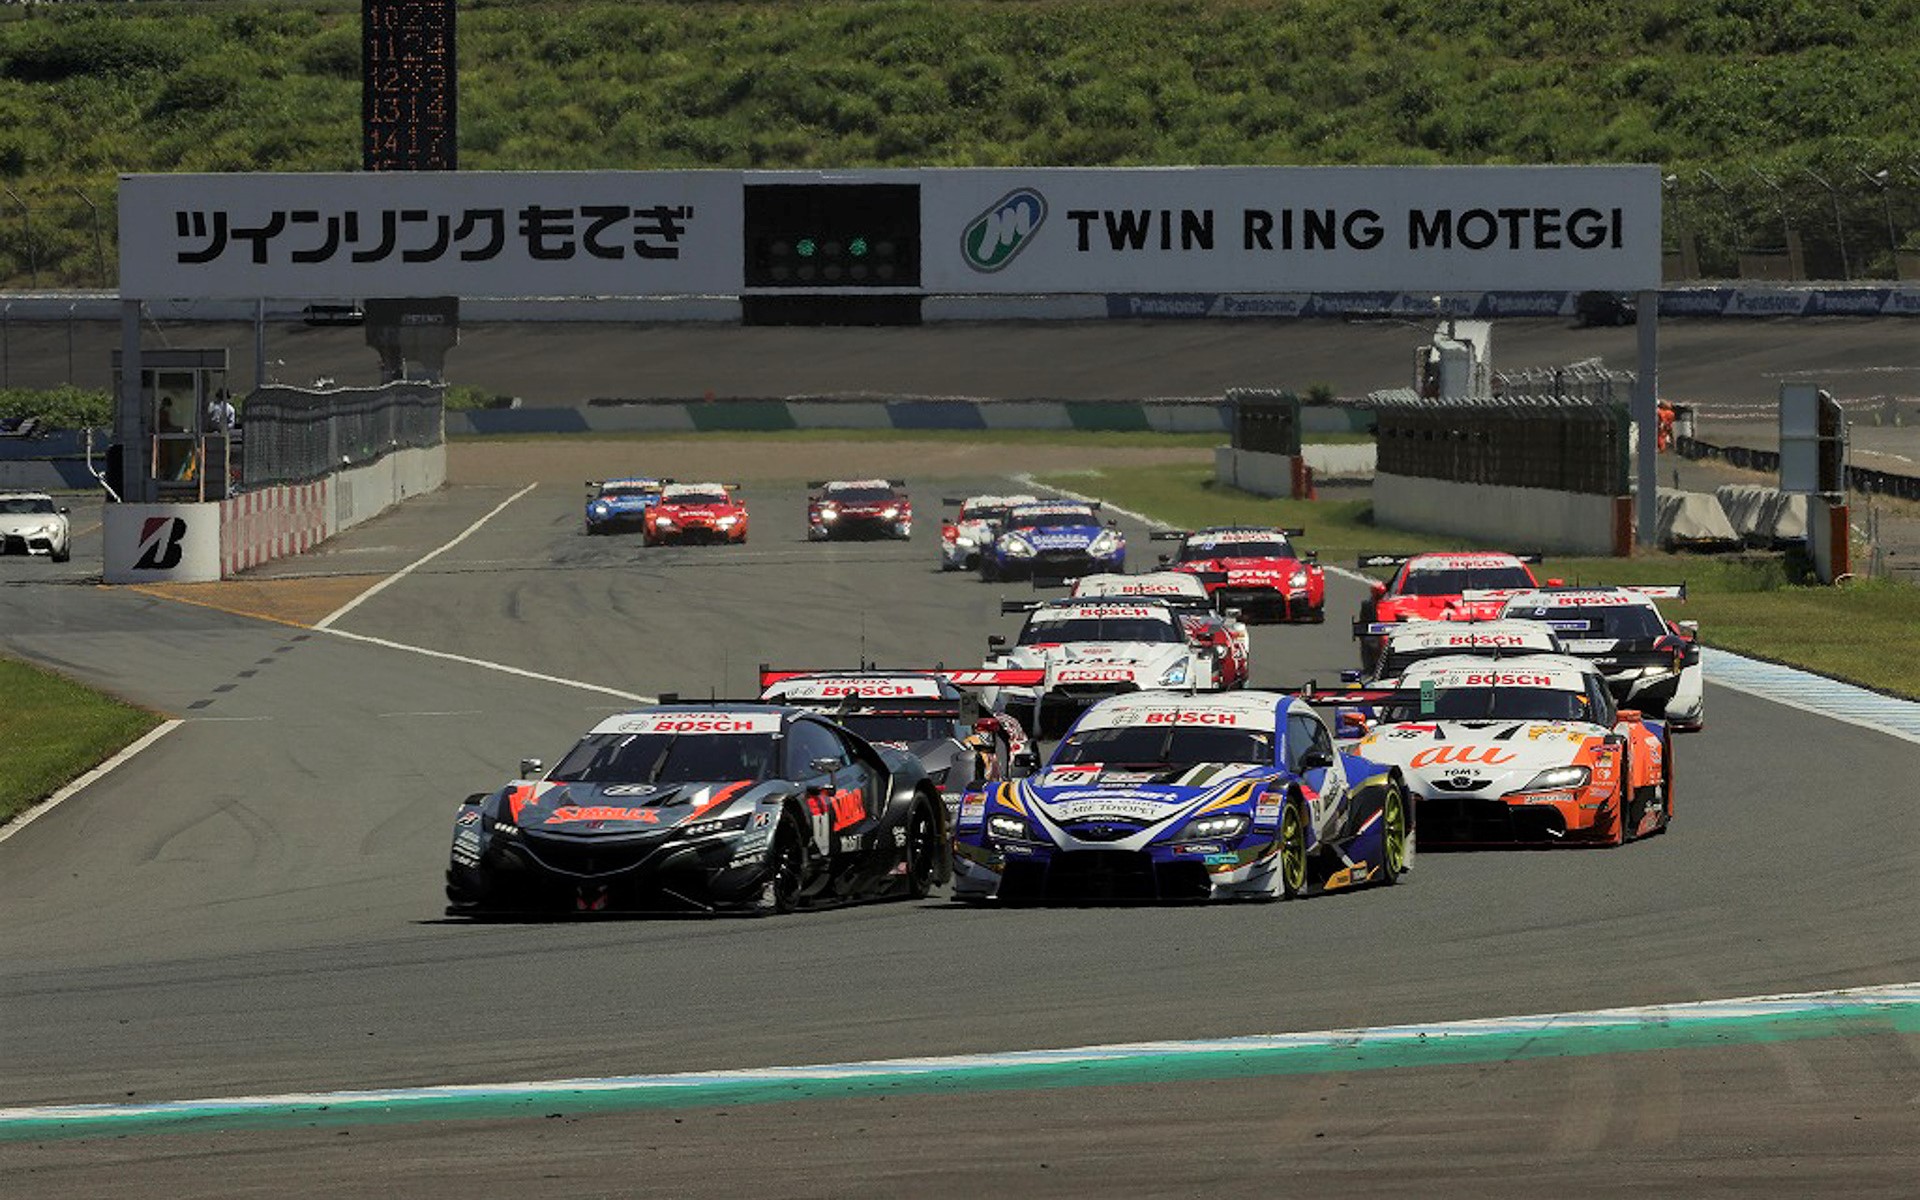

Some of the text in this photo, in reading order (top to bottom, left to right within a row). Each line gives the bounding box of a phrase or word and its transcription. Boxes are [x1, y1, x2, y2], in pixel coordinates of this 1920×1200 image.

[1067, 207, 1623, 251] TWIN RING MOTEGI
[1079, 609, 1149, 618] BOSCH
[1449, 635, 1524, 646] BOSCH
[1060, 671, 1134, 681] MOTUL
[1466, 674, 1552, 686] BOSCH
[821, 685, 915, 696] BOSCH
[1145, 711, 1237, 725] BOSCH
[653, 720, 753, 732] BOSCH
[1410, 745, 1519, 769] au
